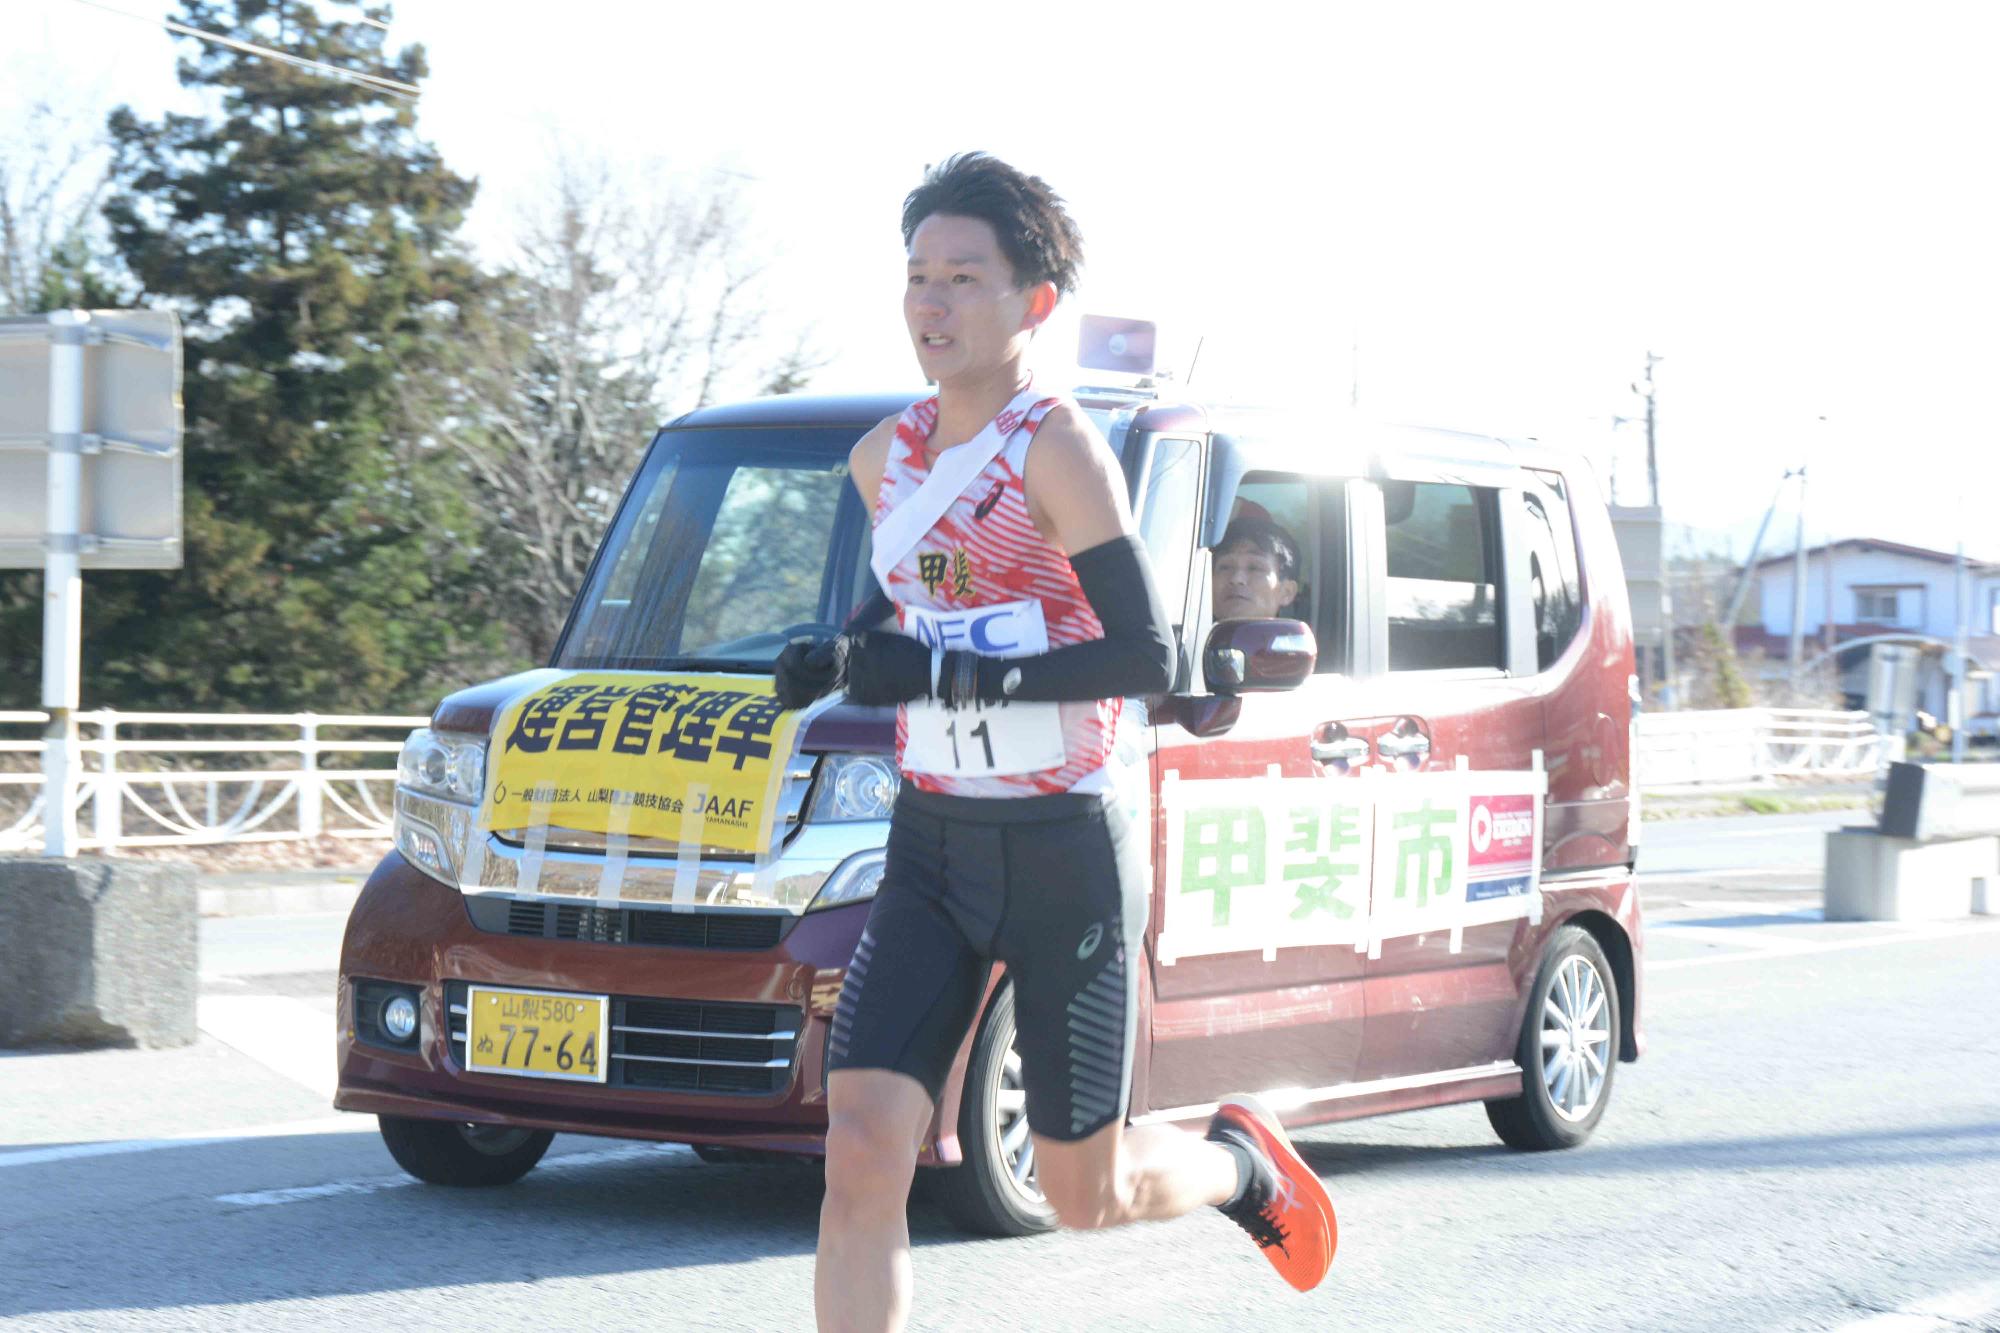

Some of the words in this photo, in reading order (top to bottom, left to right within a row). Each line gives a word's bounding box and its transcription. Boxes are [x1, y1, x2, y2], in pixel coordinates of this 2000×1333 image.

[505, 682, 785, 771] 運営管理車
[945, 719, 995, 770] 11
[692, 792, 754, 818] JAAF
[1180, 799, 1457, 927] 甲斐市
[500, 1024, 597, 1073] 77-64
